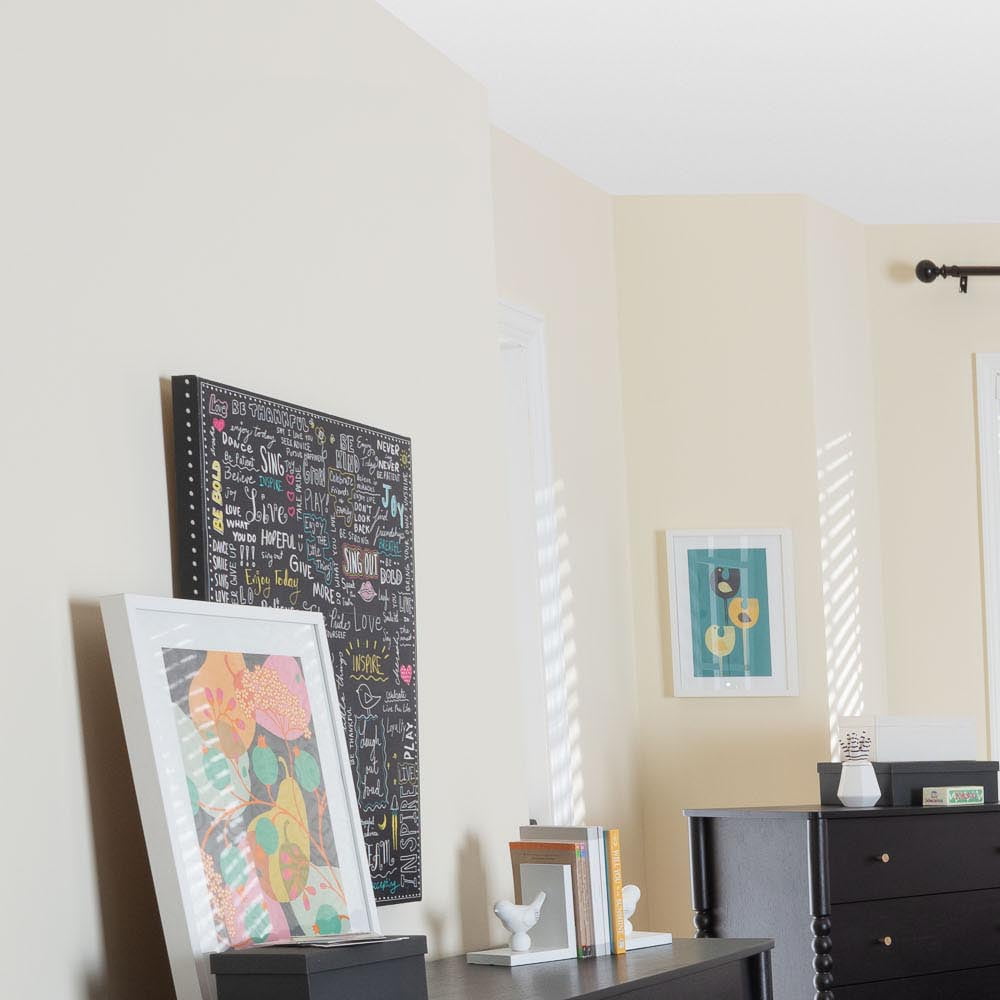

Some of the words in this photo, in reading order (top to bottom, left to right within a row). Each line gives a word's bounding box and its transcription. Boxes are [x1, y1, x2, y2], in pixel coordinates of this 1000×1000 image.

[232, 400, 246, 415] BE
[248, 403, 309, 433] THANKFUL
[340, 433, 355, 453] BE
[376, 439, 400, 456] NEVER
[260, 446, 285, 476] SING
[336, 449, 360, 474] KIND
[378, 459, 400, 473] NEVER
[211, 460, 222, 507] BOLD
[225, 467, 257, 485] Believe
[295, 466, 303, 493] PRIDE
[225, 504, 242, 518] LOVE
[244, 485, 289, 525] Live
[304, 488, 330, 516] PLAY!
[354, 502, 373, 514] DON'T
[381, 484, 404, 529] JOY
[212, 507, 225, 536] BE
[226, 519, 250, 530] WHAT
[354, 514, 372, 524] LOOK
[354, 524, 371, 536] BACK
[233, 531, 246, 542] YOU
[247, 533, 257, 543] DO
[261, 529, 297, 550] HOPEFUL
[339, 528, 348, 539] BE
[229, 543, 237, 559] UP
[343, 547, 363, 574] SING
[364, 551, 379, 577] OUT
[212, 555, 229, 572] SMILE
[289, 554, 315, 581] GIVE
[245, 568, 271, 599] Enjoy
[274, 568, 301, 606] Today
[380, 569, 403, 585] BOLD
[312, 582, 336, 605] MORE
[354, 606, 386, 633] Love
[352, 654, 385, 675] INSPIRE
[347, 706, 355, 748] THANKFUL
[403, 721, 416, 761] PLAY
[400, 785, 419, 889] INSPIRE
